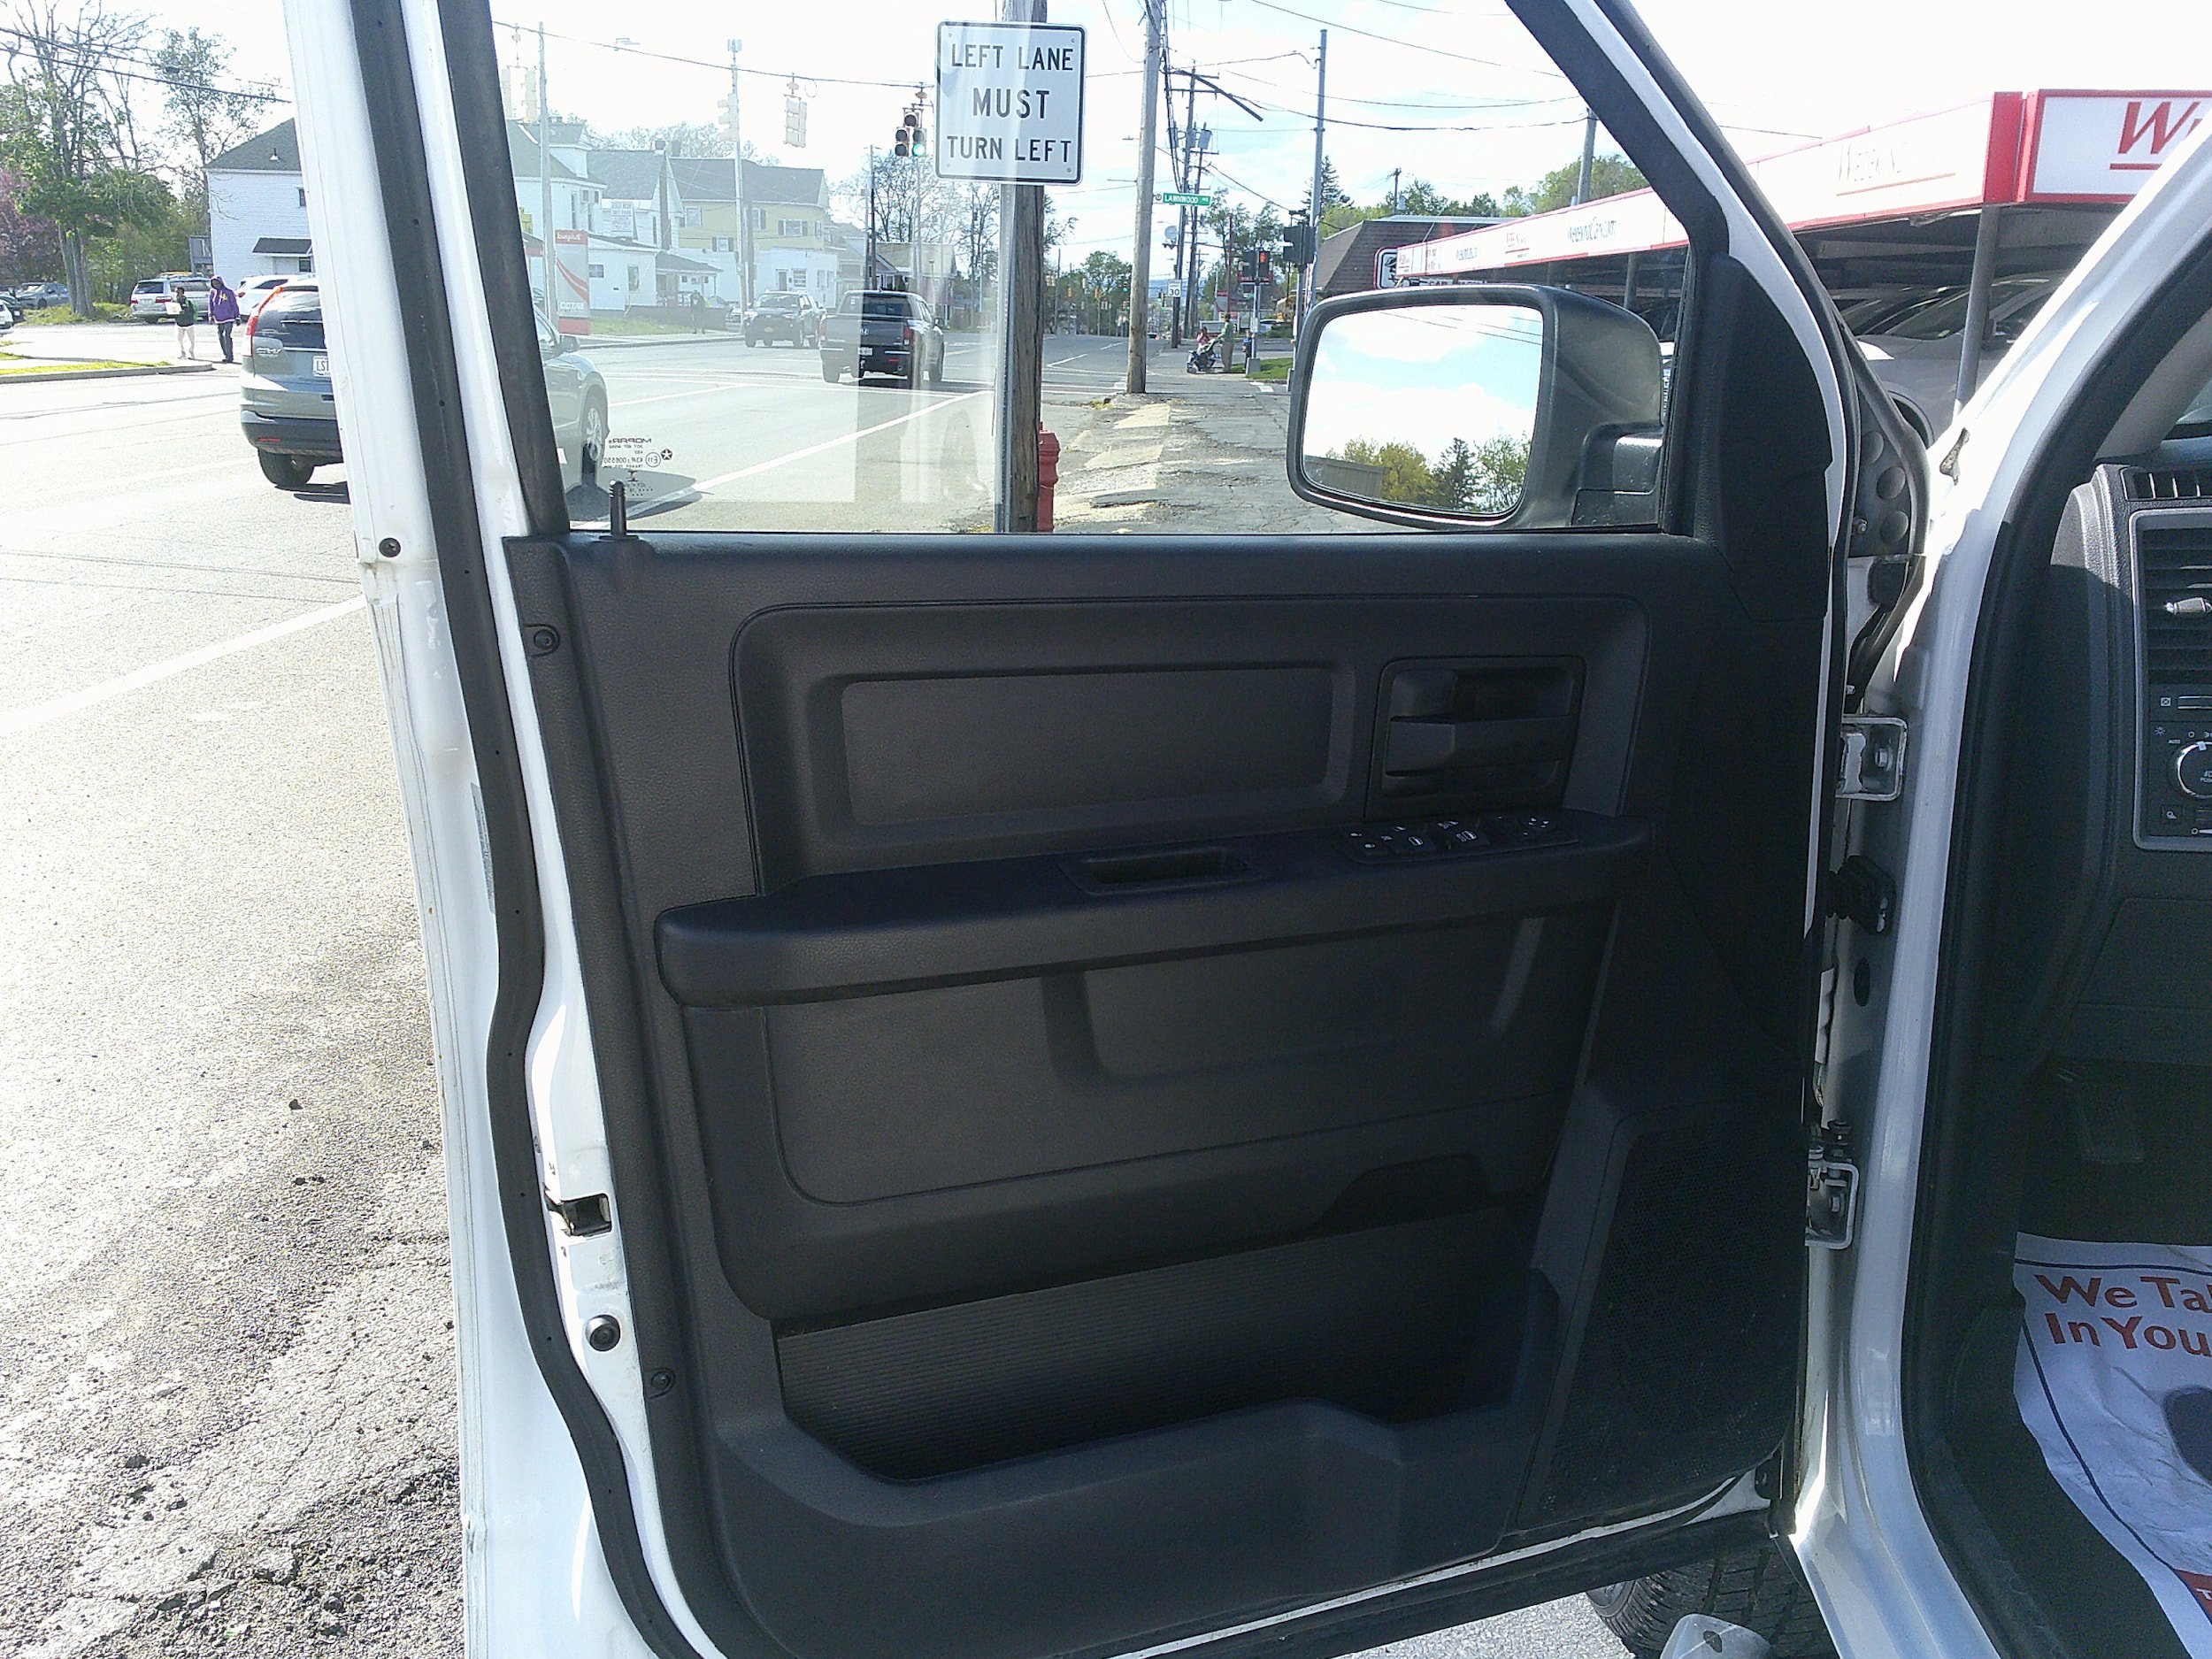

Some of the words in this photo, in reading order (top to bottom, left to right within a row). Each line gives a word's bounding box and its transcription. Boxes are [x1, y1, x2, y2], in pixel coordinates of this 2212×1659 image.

[951, 43, 1003, 68] LEFT
[1018, 46, 1073, 71] LANE
[973, 88, 1049, 119] MUST
[947, 135, 1002, 160] TURN
[1015, 138, 1071, 163] LEFT
[2034, 1274, 2138, 1308] We
[2044, 1312, 2101, 1347] In
